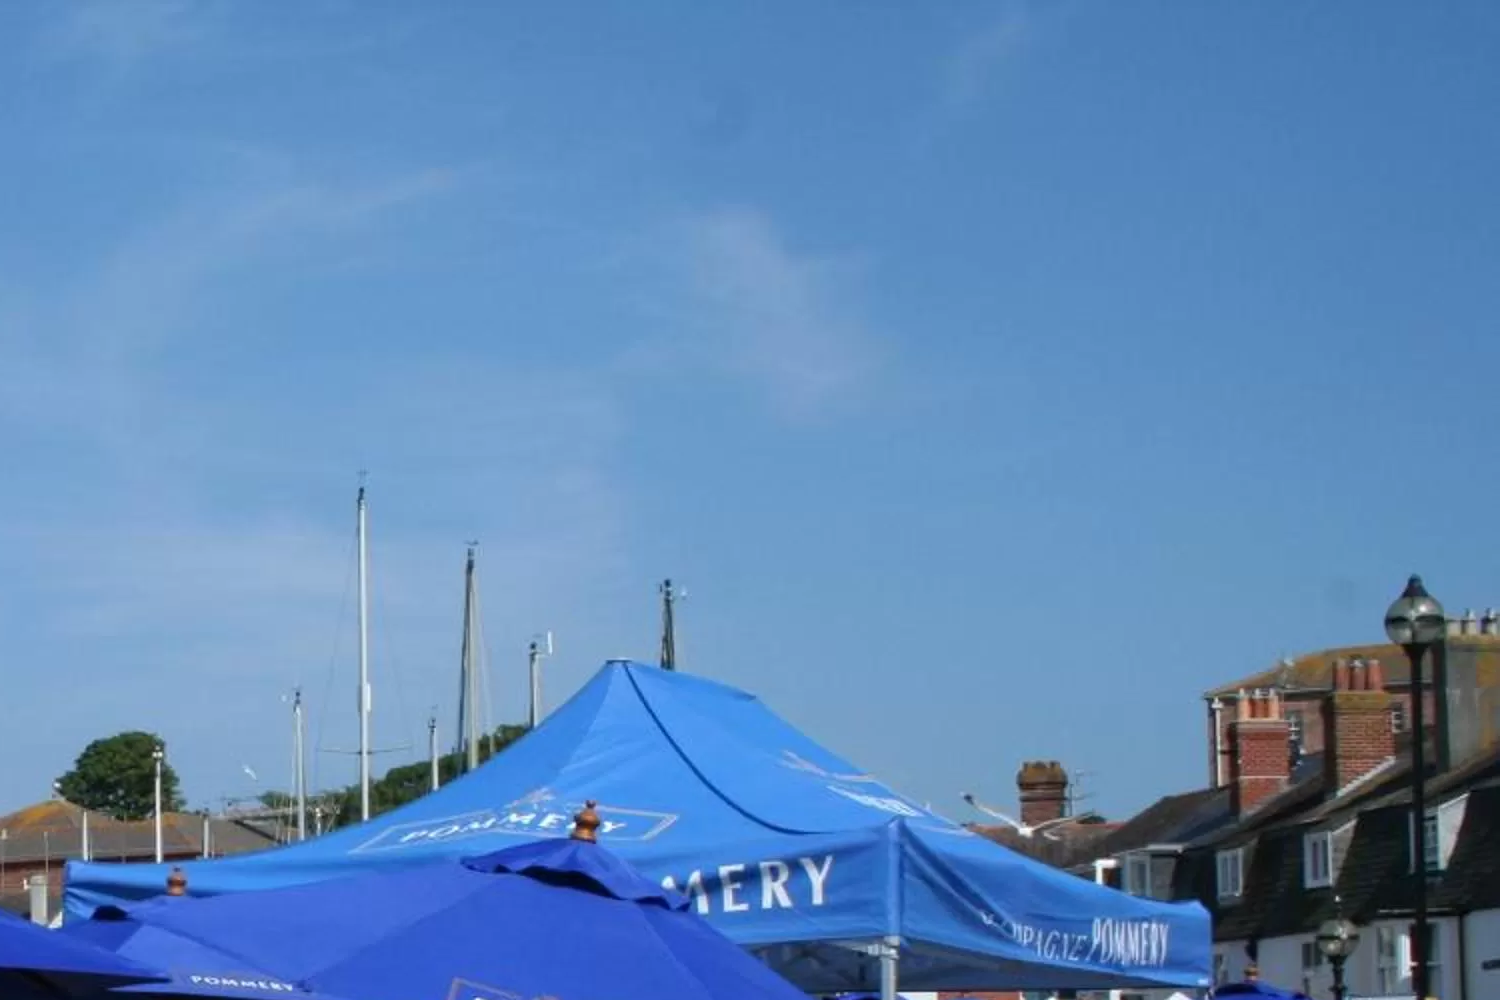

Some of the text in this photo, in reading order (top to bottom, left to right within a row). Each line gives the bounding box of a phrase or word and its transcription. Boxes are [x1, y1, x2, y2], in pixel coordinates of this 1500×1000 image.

[401, 812, 628, 843] POMMEY
[1087, 917, 1169, 967] POMMERY
[190, 975, 293, 992] POMMERY
